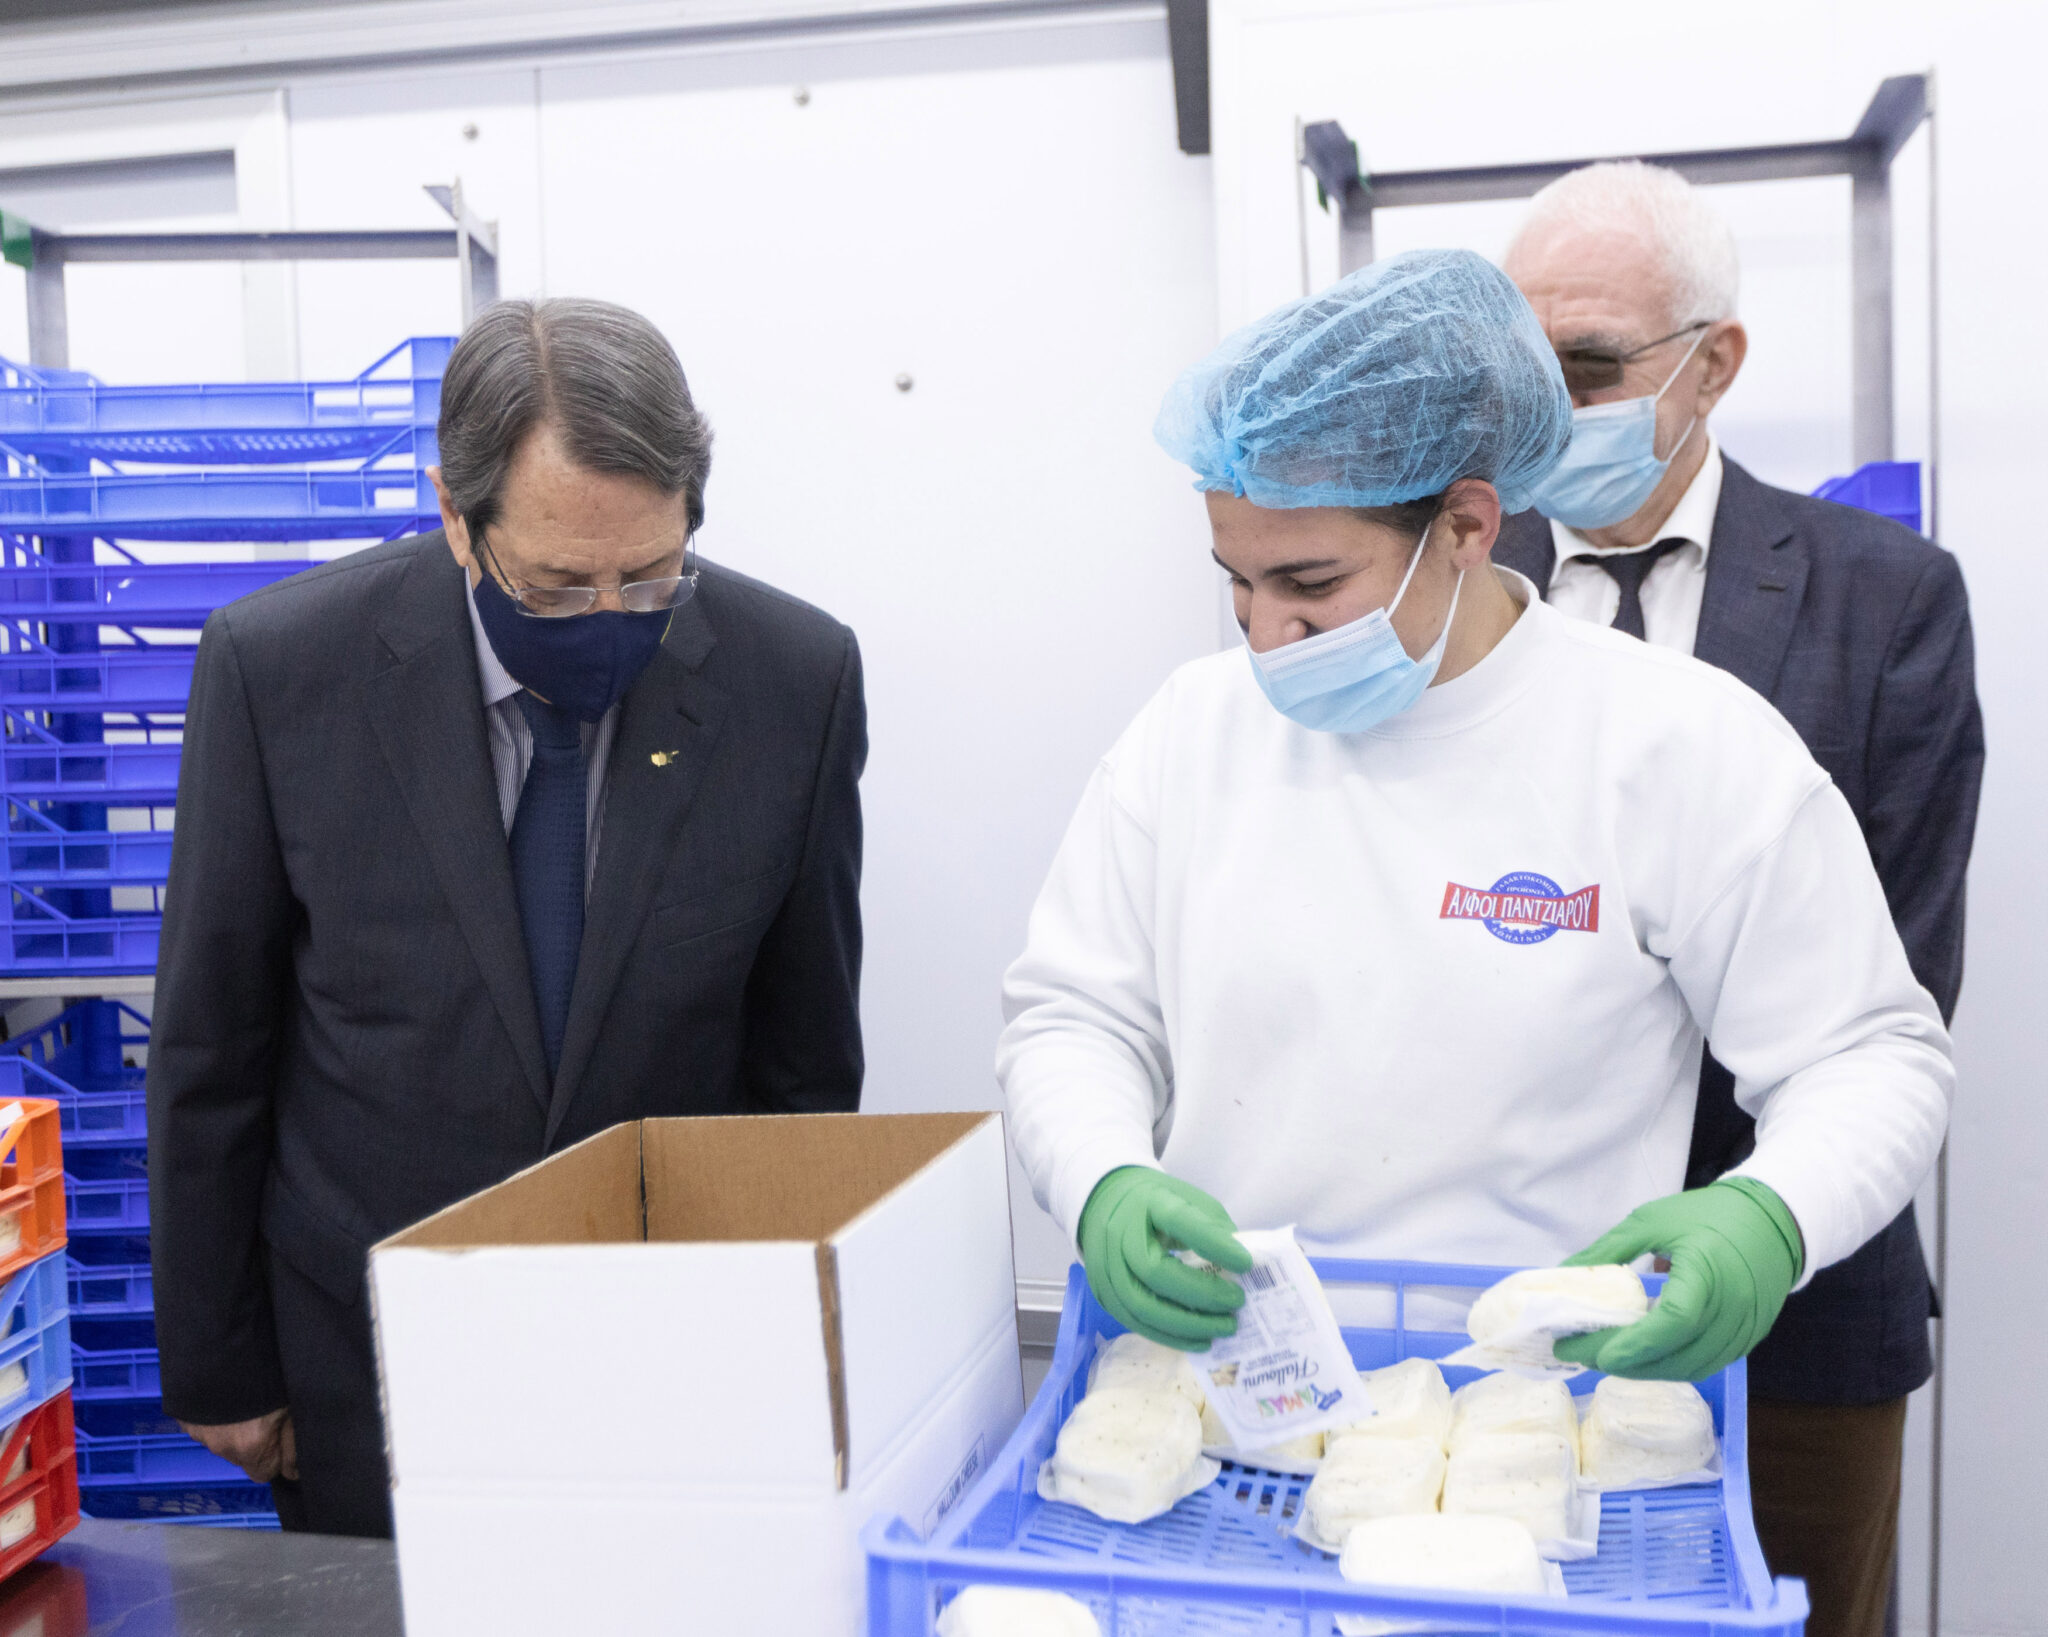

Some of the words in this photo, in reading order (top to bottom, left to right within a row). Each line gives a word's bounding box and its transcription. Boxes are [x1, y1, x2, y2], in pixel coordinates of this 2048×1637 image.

[1447, 887, 1497, 918] Α/ΦΟΙ
[1501, 891, 1593, 928] ΠΑΝΤΖΙΑΡΟΥ
[1242, 1356, 1319, 1393] Halloumi
